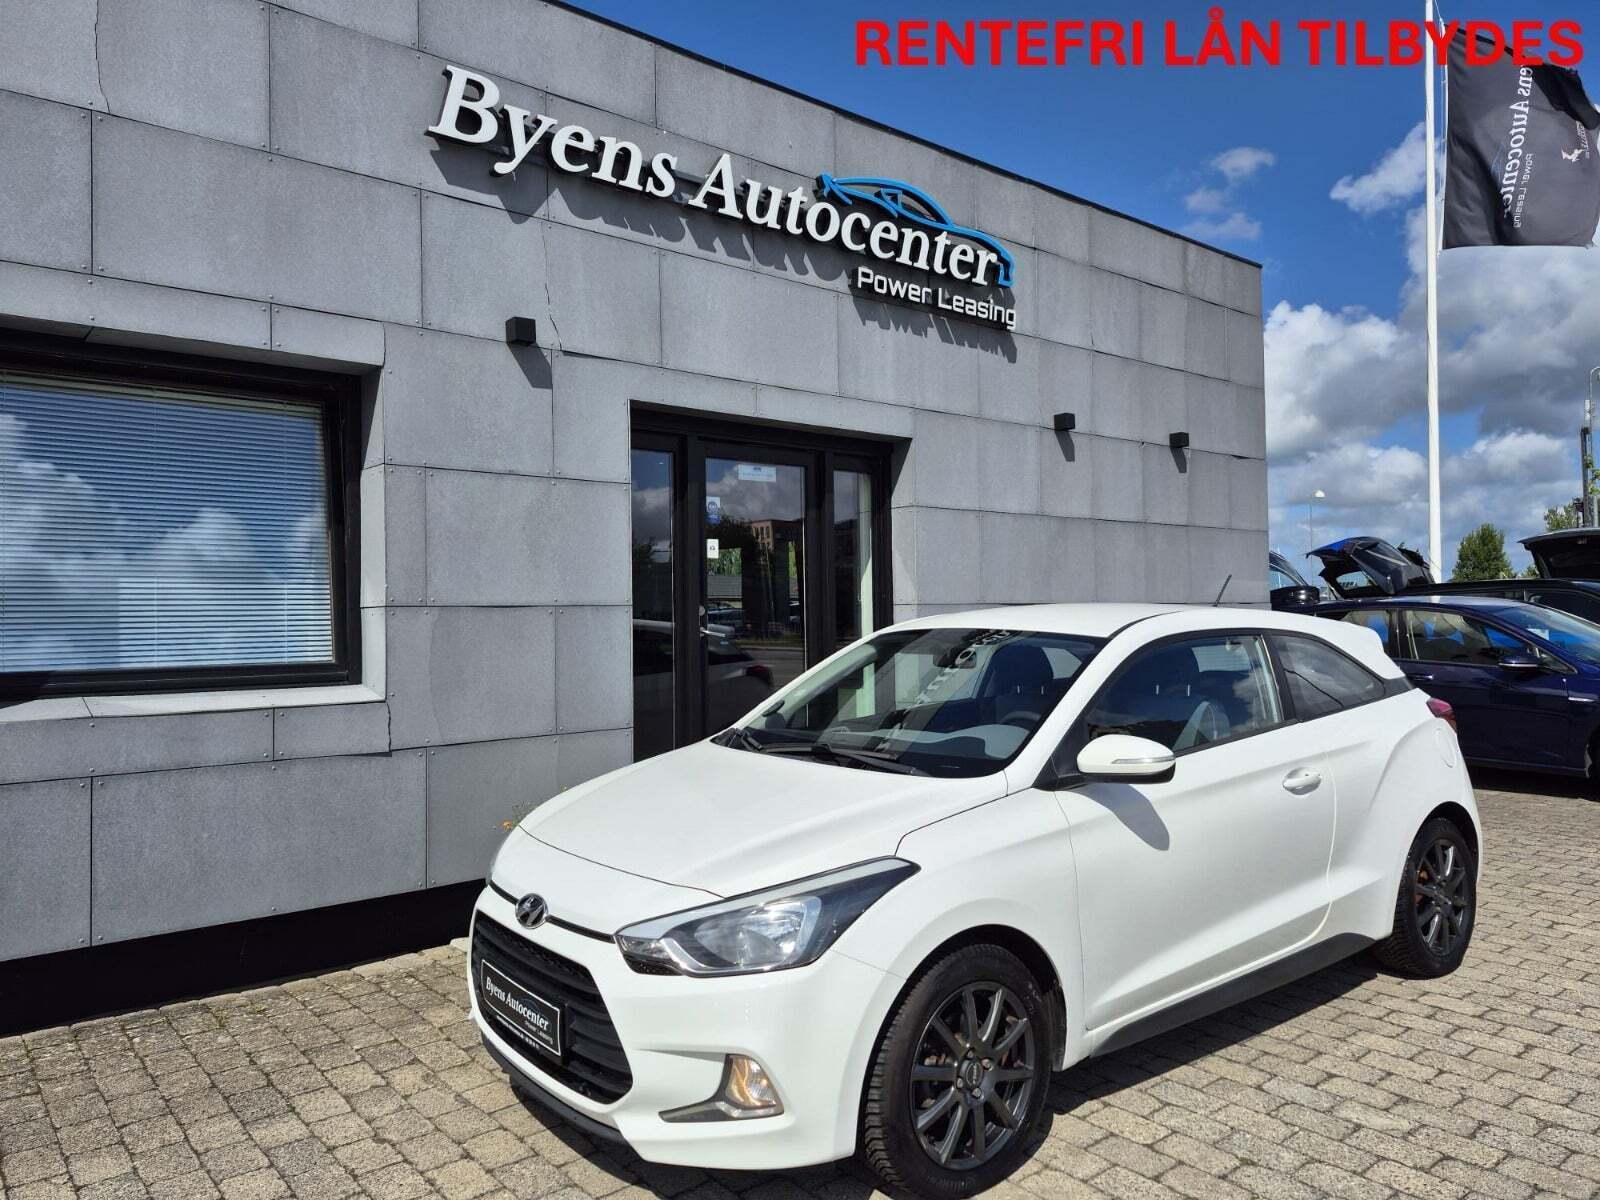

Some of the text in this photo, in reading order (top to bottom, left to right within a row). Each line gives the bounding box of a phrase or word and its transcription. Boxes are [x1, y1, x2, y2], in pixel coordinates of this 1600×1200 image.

[426, 64, 998, 286] Byens Autocenter
[857, 266, 1017, 330] Power Leasing
[486, 976, 549, 1031] Byens Autocenter
